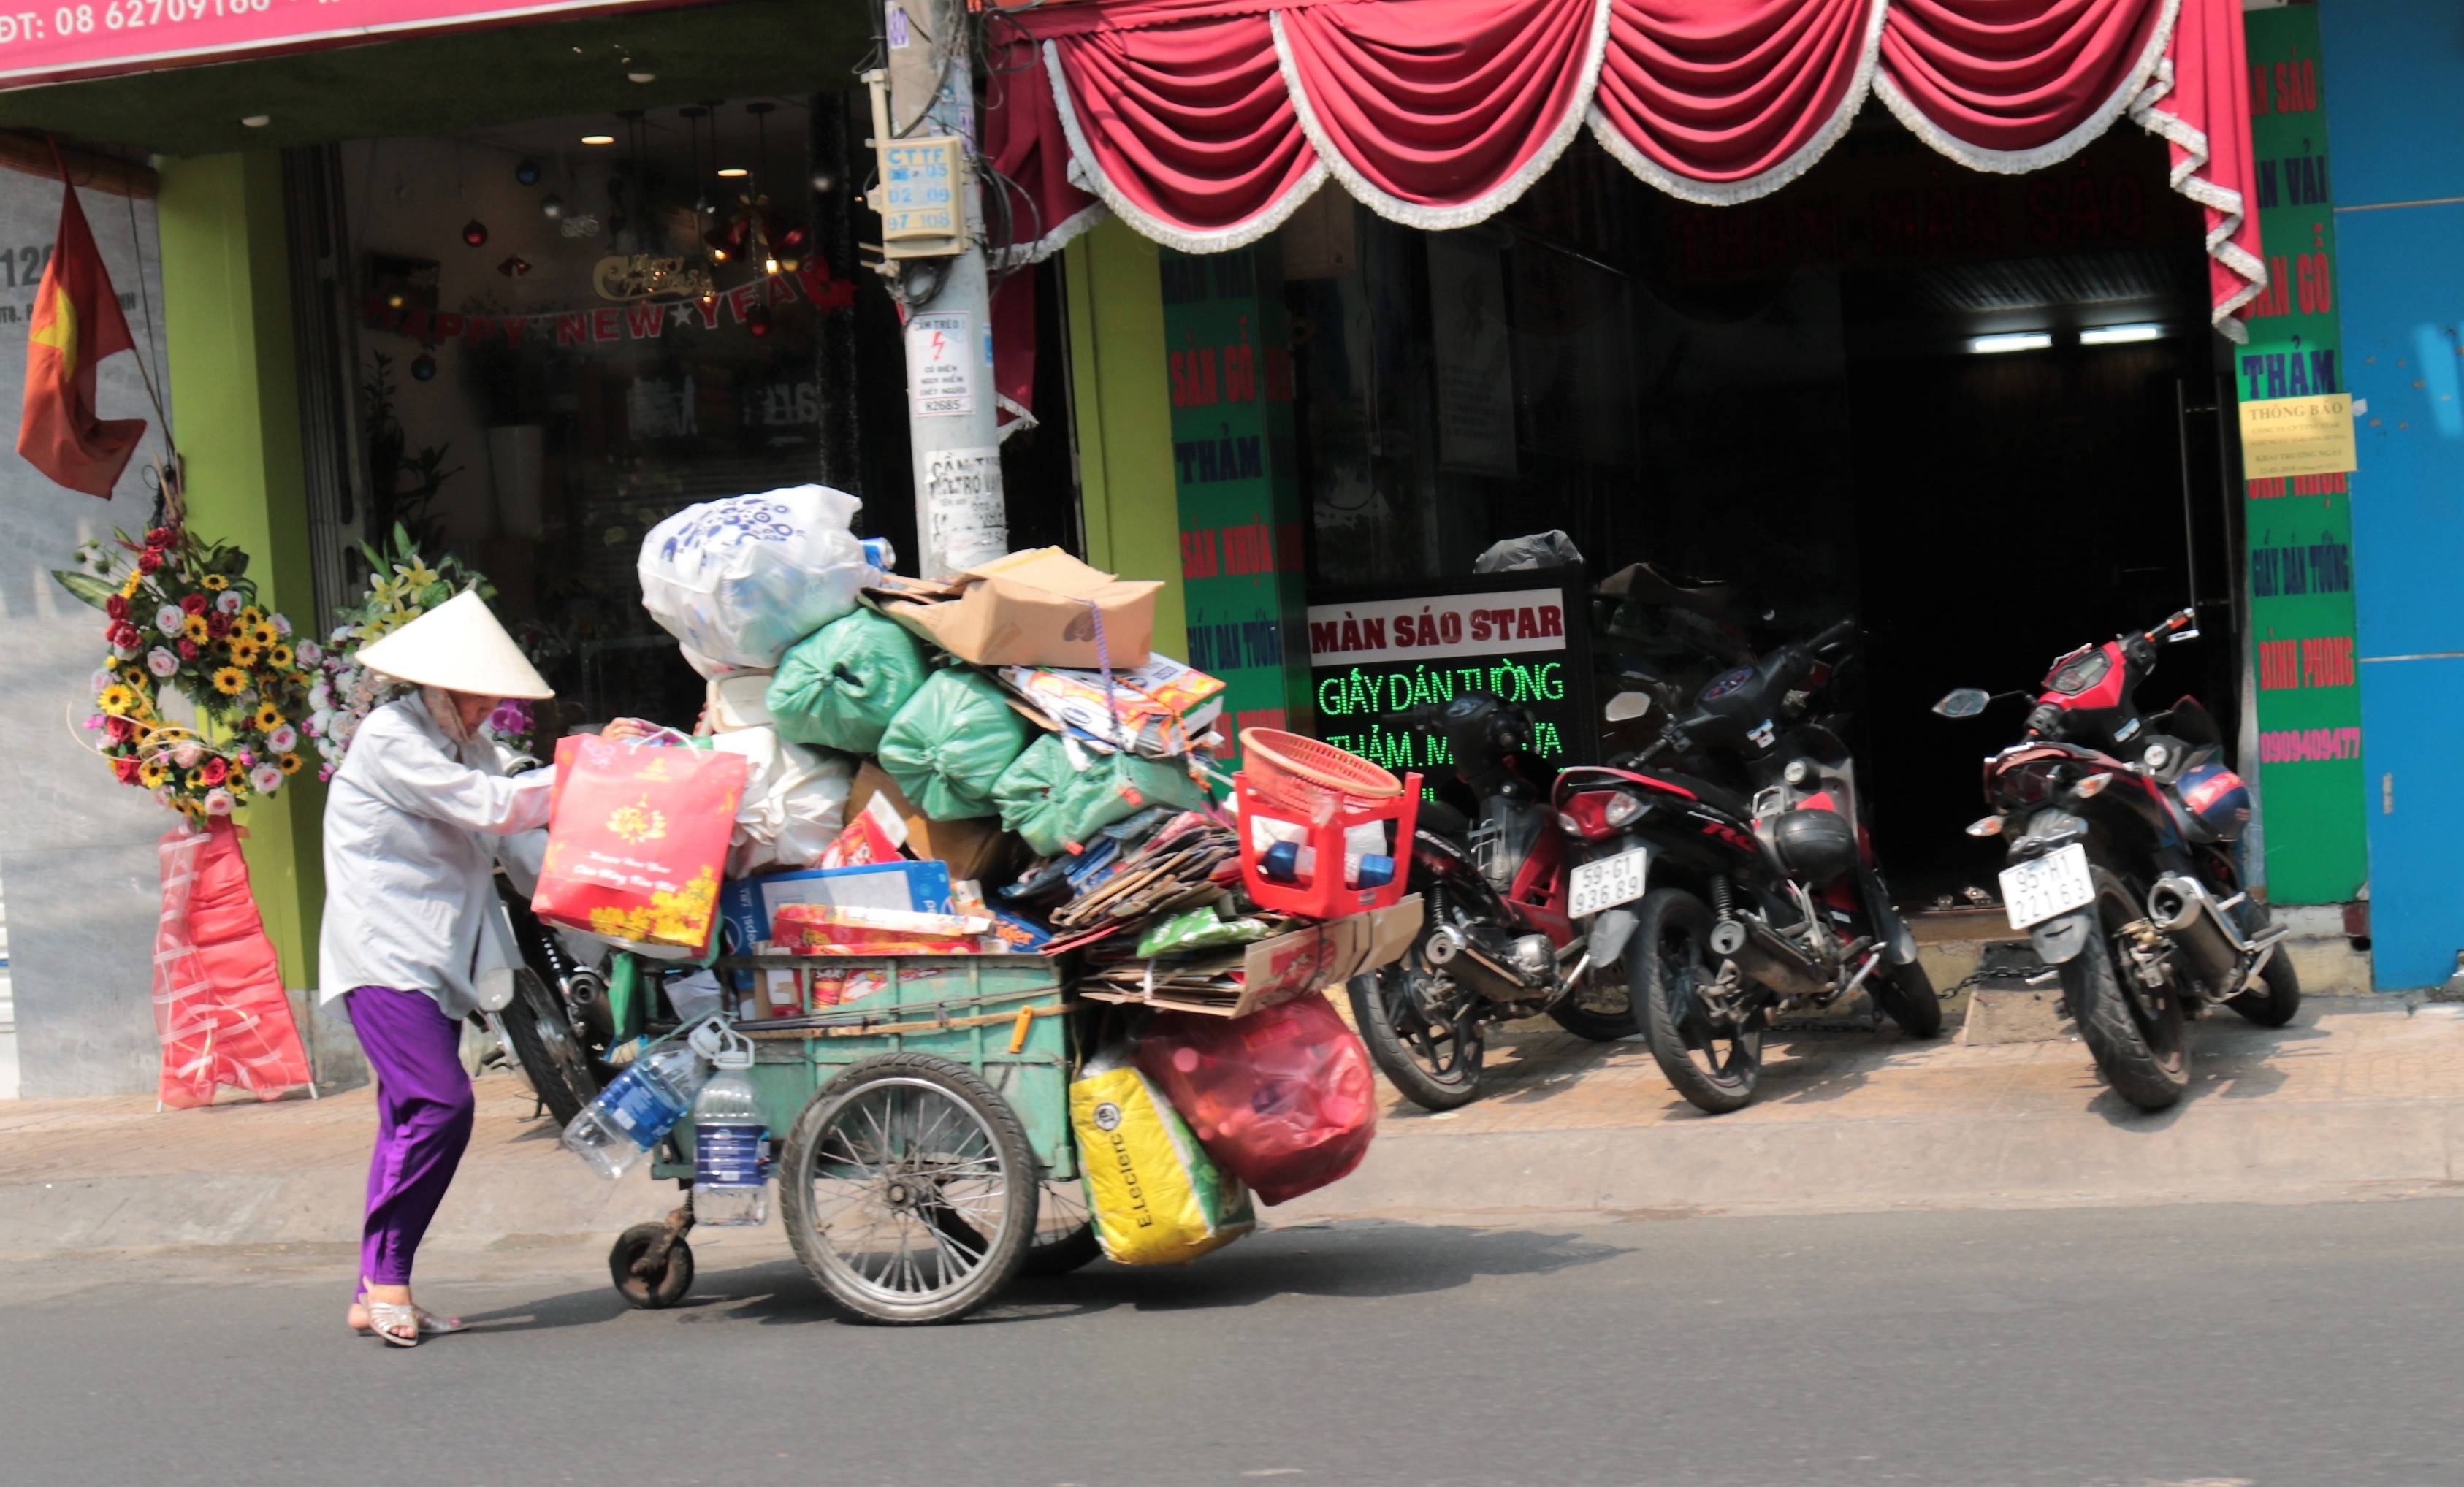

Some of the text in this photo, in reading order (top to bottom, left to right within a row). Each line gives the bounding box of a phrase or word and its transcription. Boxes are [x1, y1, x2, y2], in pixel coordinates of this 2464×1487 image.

[0, 12, 45, 42] ĐT:
[55, 5, 94, 36] 08
[2273, 45, 2317, 115] SÁO
[2284, 137, 2328, 207] VẢI
[2296, 223, 2331, 315] GỖ
[557, 304, 667, 346] NEW
[1224, 316, 1255, 402] GỖ
[2242, 333, 2336, 400] THẢM
[2249, 400, 2343, 421] THÔNG BÁO
[1175, 421, 1263, 485] THẢM
[1310, 604, 1563, 654] MÀN SÁO STAR
[1319, 667, 1384, 715] GIẤY
[1389, 665, 1453, 711] DÁN
[2301, 635, 2354, 688] PHONG
[1582, 855, 1632, 889] 59-G1
[1109, 1132, 1153, 1229] E.Leclerc
